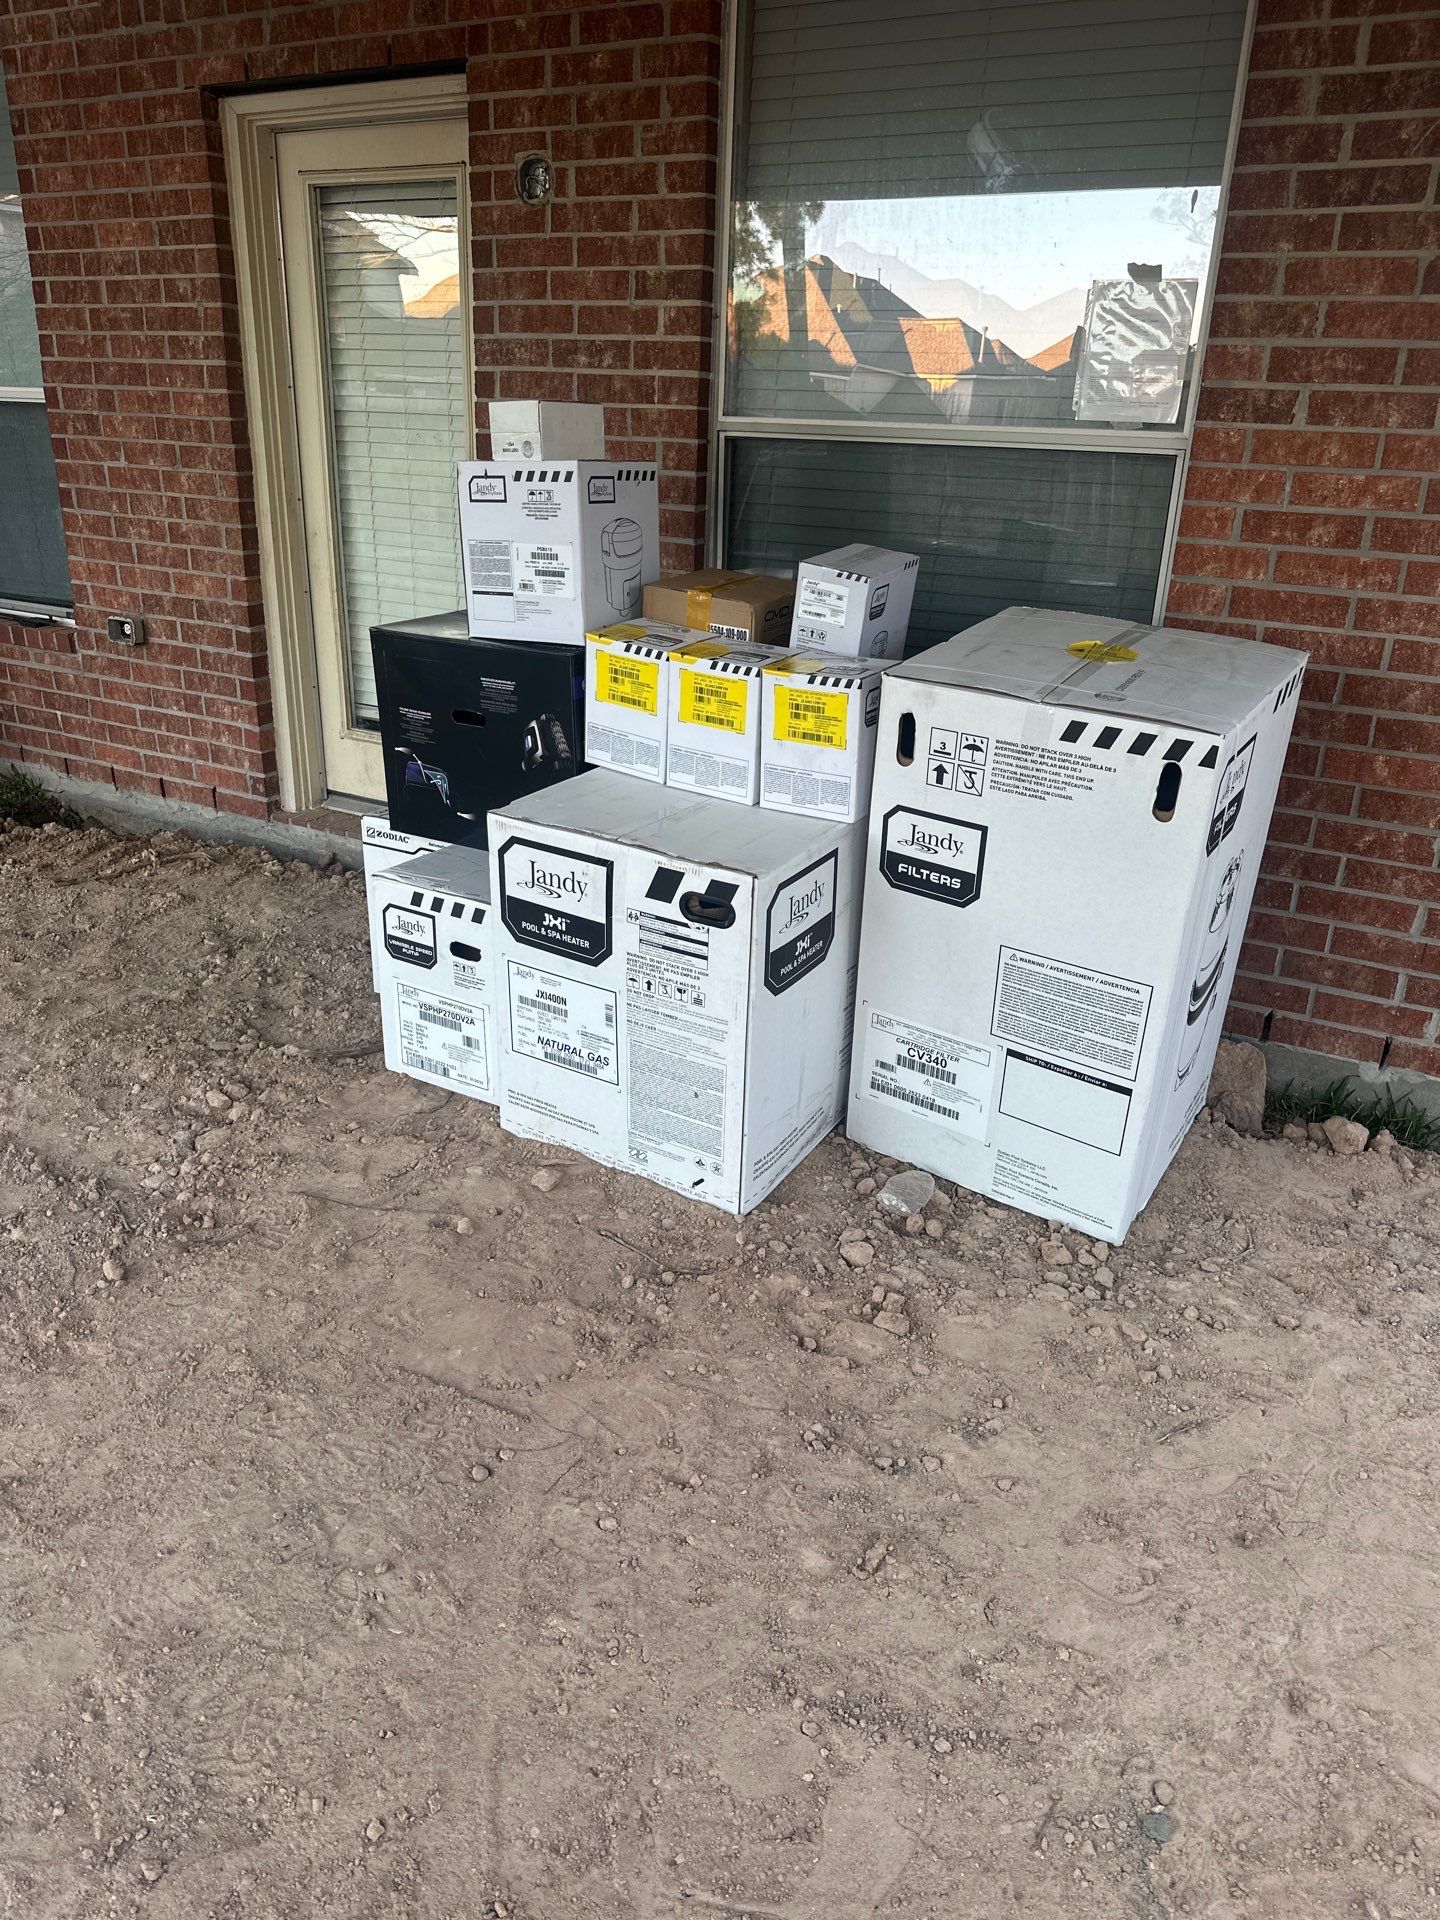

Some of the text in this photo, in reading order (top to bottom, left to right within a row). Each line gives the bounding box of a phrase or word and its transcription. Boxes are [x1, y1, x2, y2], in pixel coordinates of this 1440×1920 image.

[1041, 747, 1058, 756] STACK
[1059, 751, 1073, 759] OVER
[1039, 760, 1059, 769] APILAR
[1058, 758, 1080, 767] EMPILER
[991, 772, 1006, 780] CETTE
[1033, 780, 1045, 788] VERS
[1048, 777, 1061, 785] AVEC
[1015, 790, 1028, 798] PARA
[1022, 786, 1040, 794] TRATAR
[376, 830, 408, 843] ZODIAC
[904, 823, 964, 858] Jandy
[525, 860, 589, 903] Jandy
[898, 863, 962, 889] FILTERS
[785, 880, 825, 929] Jandy
[396, 915, 426, 936] Jandy
[522, 921, 590, 949] POOL & SPA HEATER
[780, 964, 794, 977] POOL
[798, 953, 807, 965] SPA
[807, 940, 824, 960] HEATER
[666, 961, 680, 970] STACK
[681, 965, 693, 973] OVER
[1019, 956, 1141, 995] WARNING AVERTISSEMENT ADVERTENCIA
[538, 1036, 584, 1059] NATURAL
[588, 1052, 610, 1067] GAS
[896, 1038, 936, 1056] CARTRIDGE
[936, 1051, 961, 1064] FILTER
[907, 1047, 948, 1069] CV340
[1026, 1056, 1039, 1065] SHIP
[872, 1071, 889, 1080] SERIAL
[677, 1184, 694, 1195] CORTE
